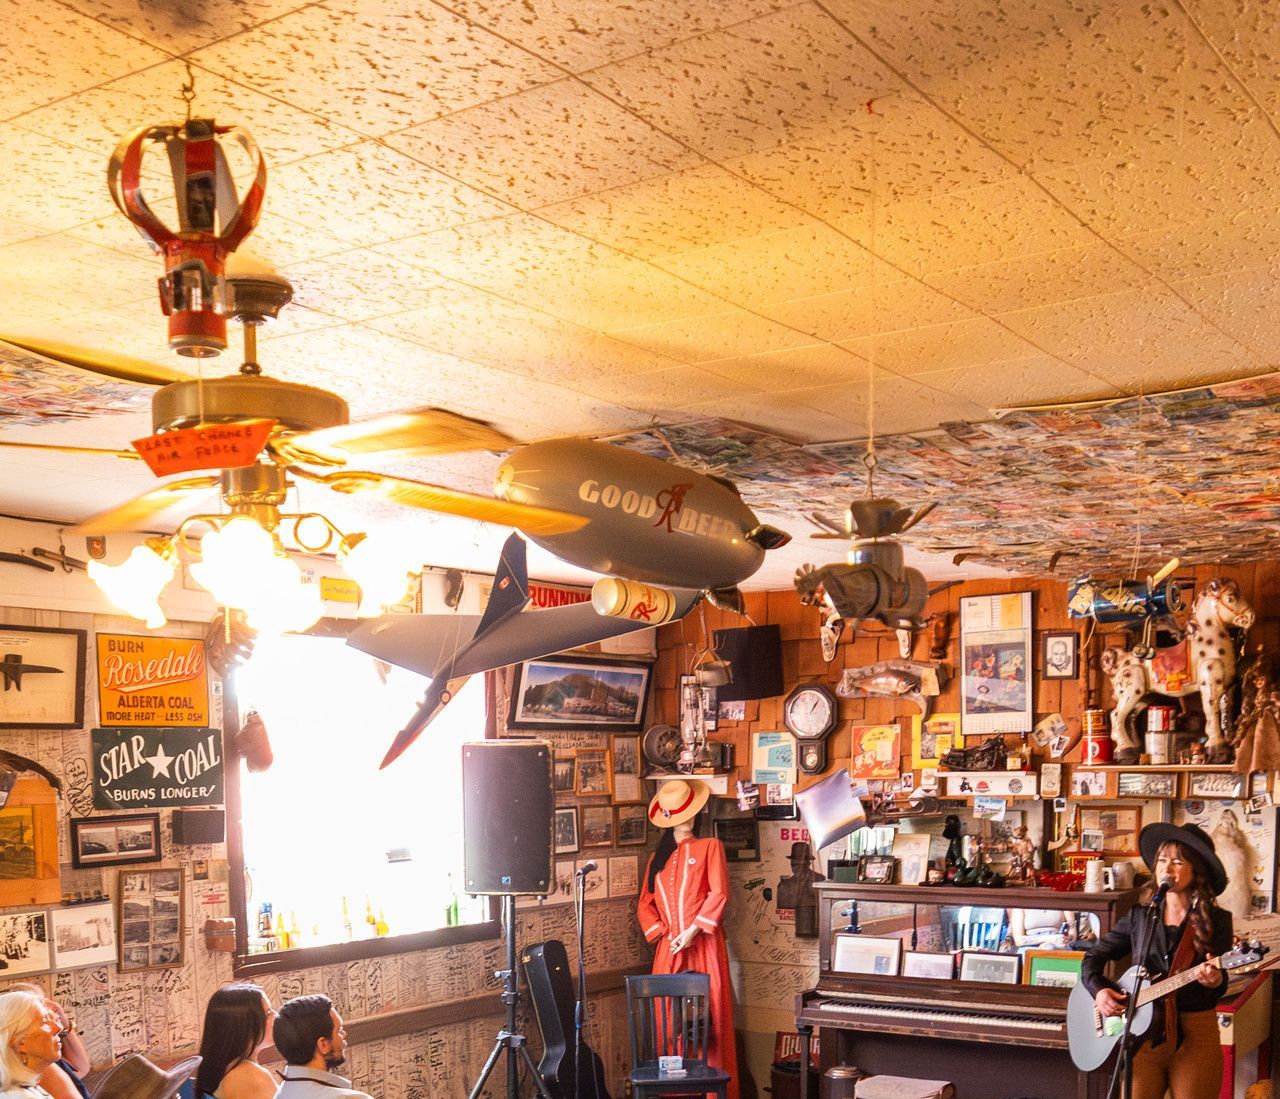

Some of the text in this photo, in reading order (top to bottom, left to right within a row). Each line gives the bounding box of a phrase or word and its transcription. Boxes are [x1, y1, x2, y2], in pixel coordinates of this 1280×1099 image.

[578, 480, 657, 518] GOOD
[108, 639, 144, 653] BURN
[103, 645, 204, 688] Rosedale
[117, 696, 194, 709] ALBERTA COAL
[106, 712, 202, 721] MORE HEAT LESS ASH
[100, 735, 147, 787] STAR
[174, 735, 220, 785] COAL
[114, 787, 208, 801] BURNS LONGER
